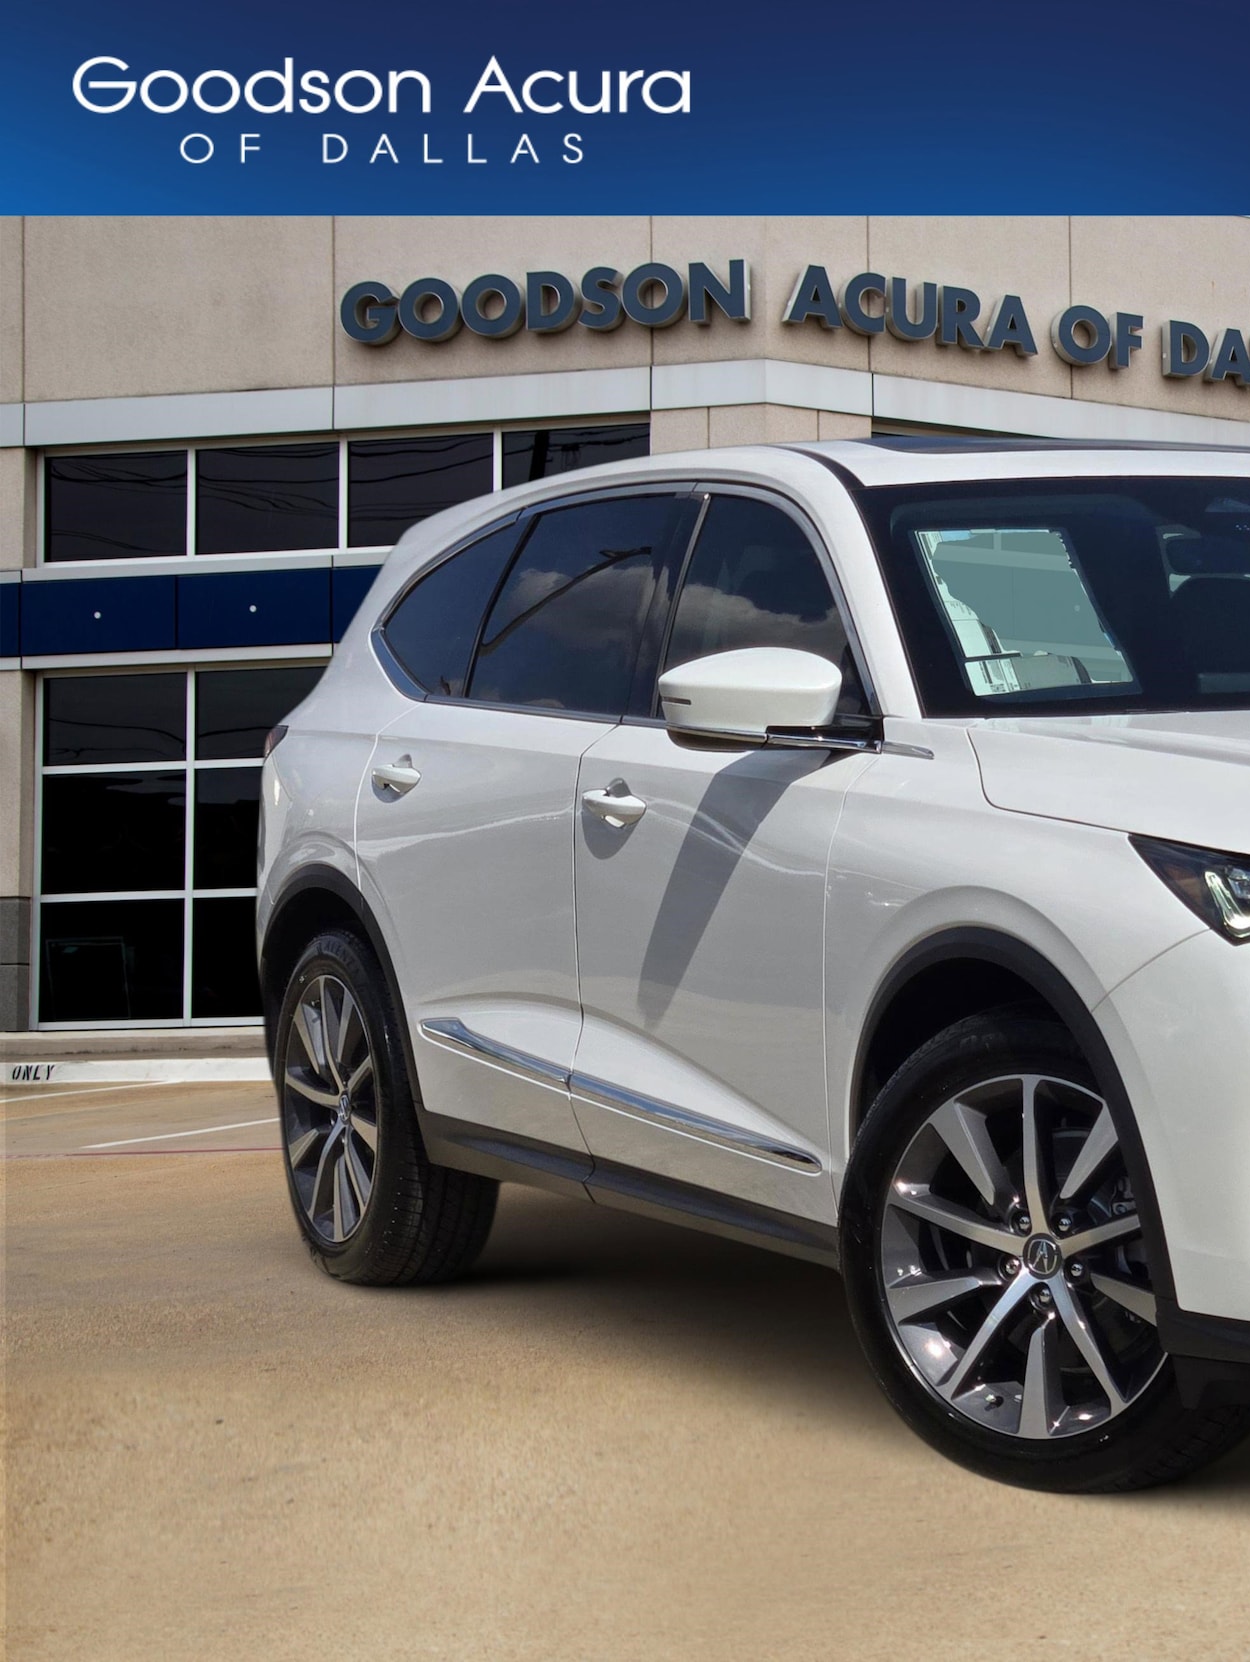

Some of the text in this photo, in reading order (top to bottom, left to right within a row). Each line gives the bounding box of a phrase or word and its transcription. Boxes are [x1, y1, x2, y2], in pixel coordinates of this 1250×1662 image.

[340, 259, 752, 346] GOODSON
[782, 264, 1038, 358] ACURA
[1050, 305, 1143, 371] OF
[11, 1064, 55, 1081] ONLY
